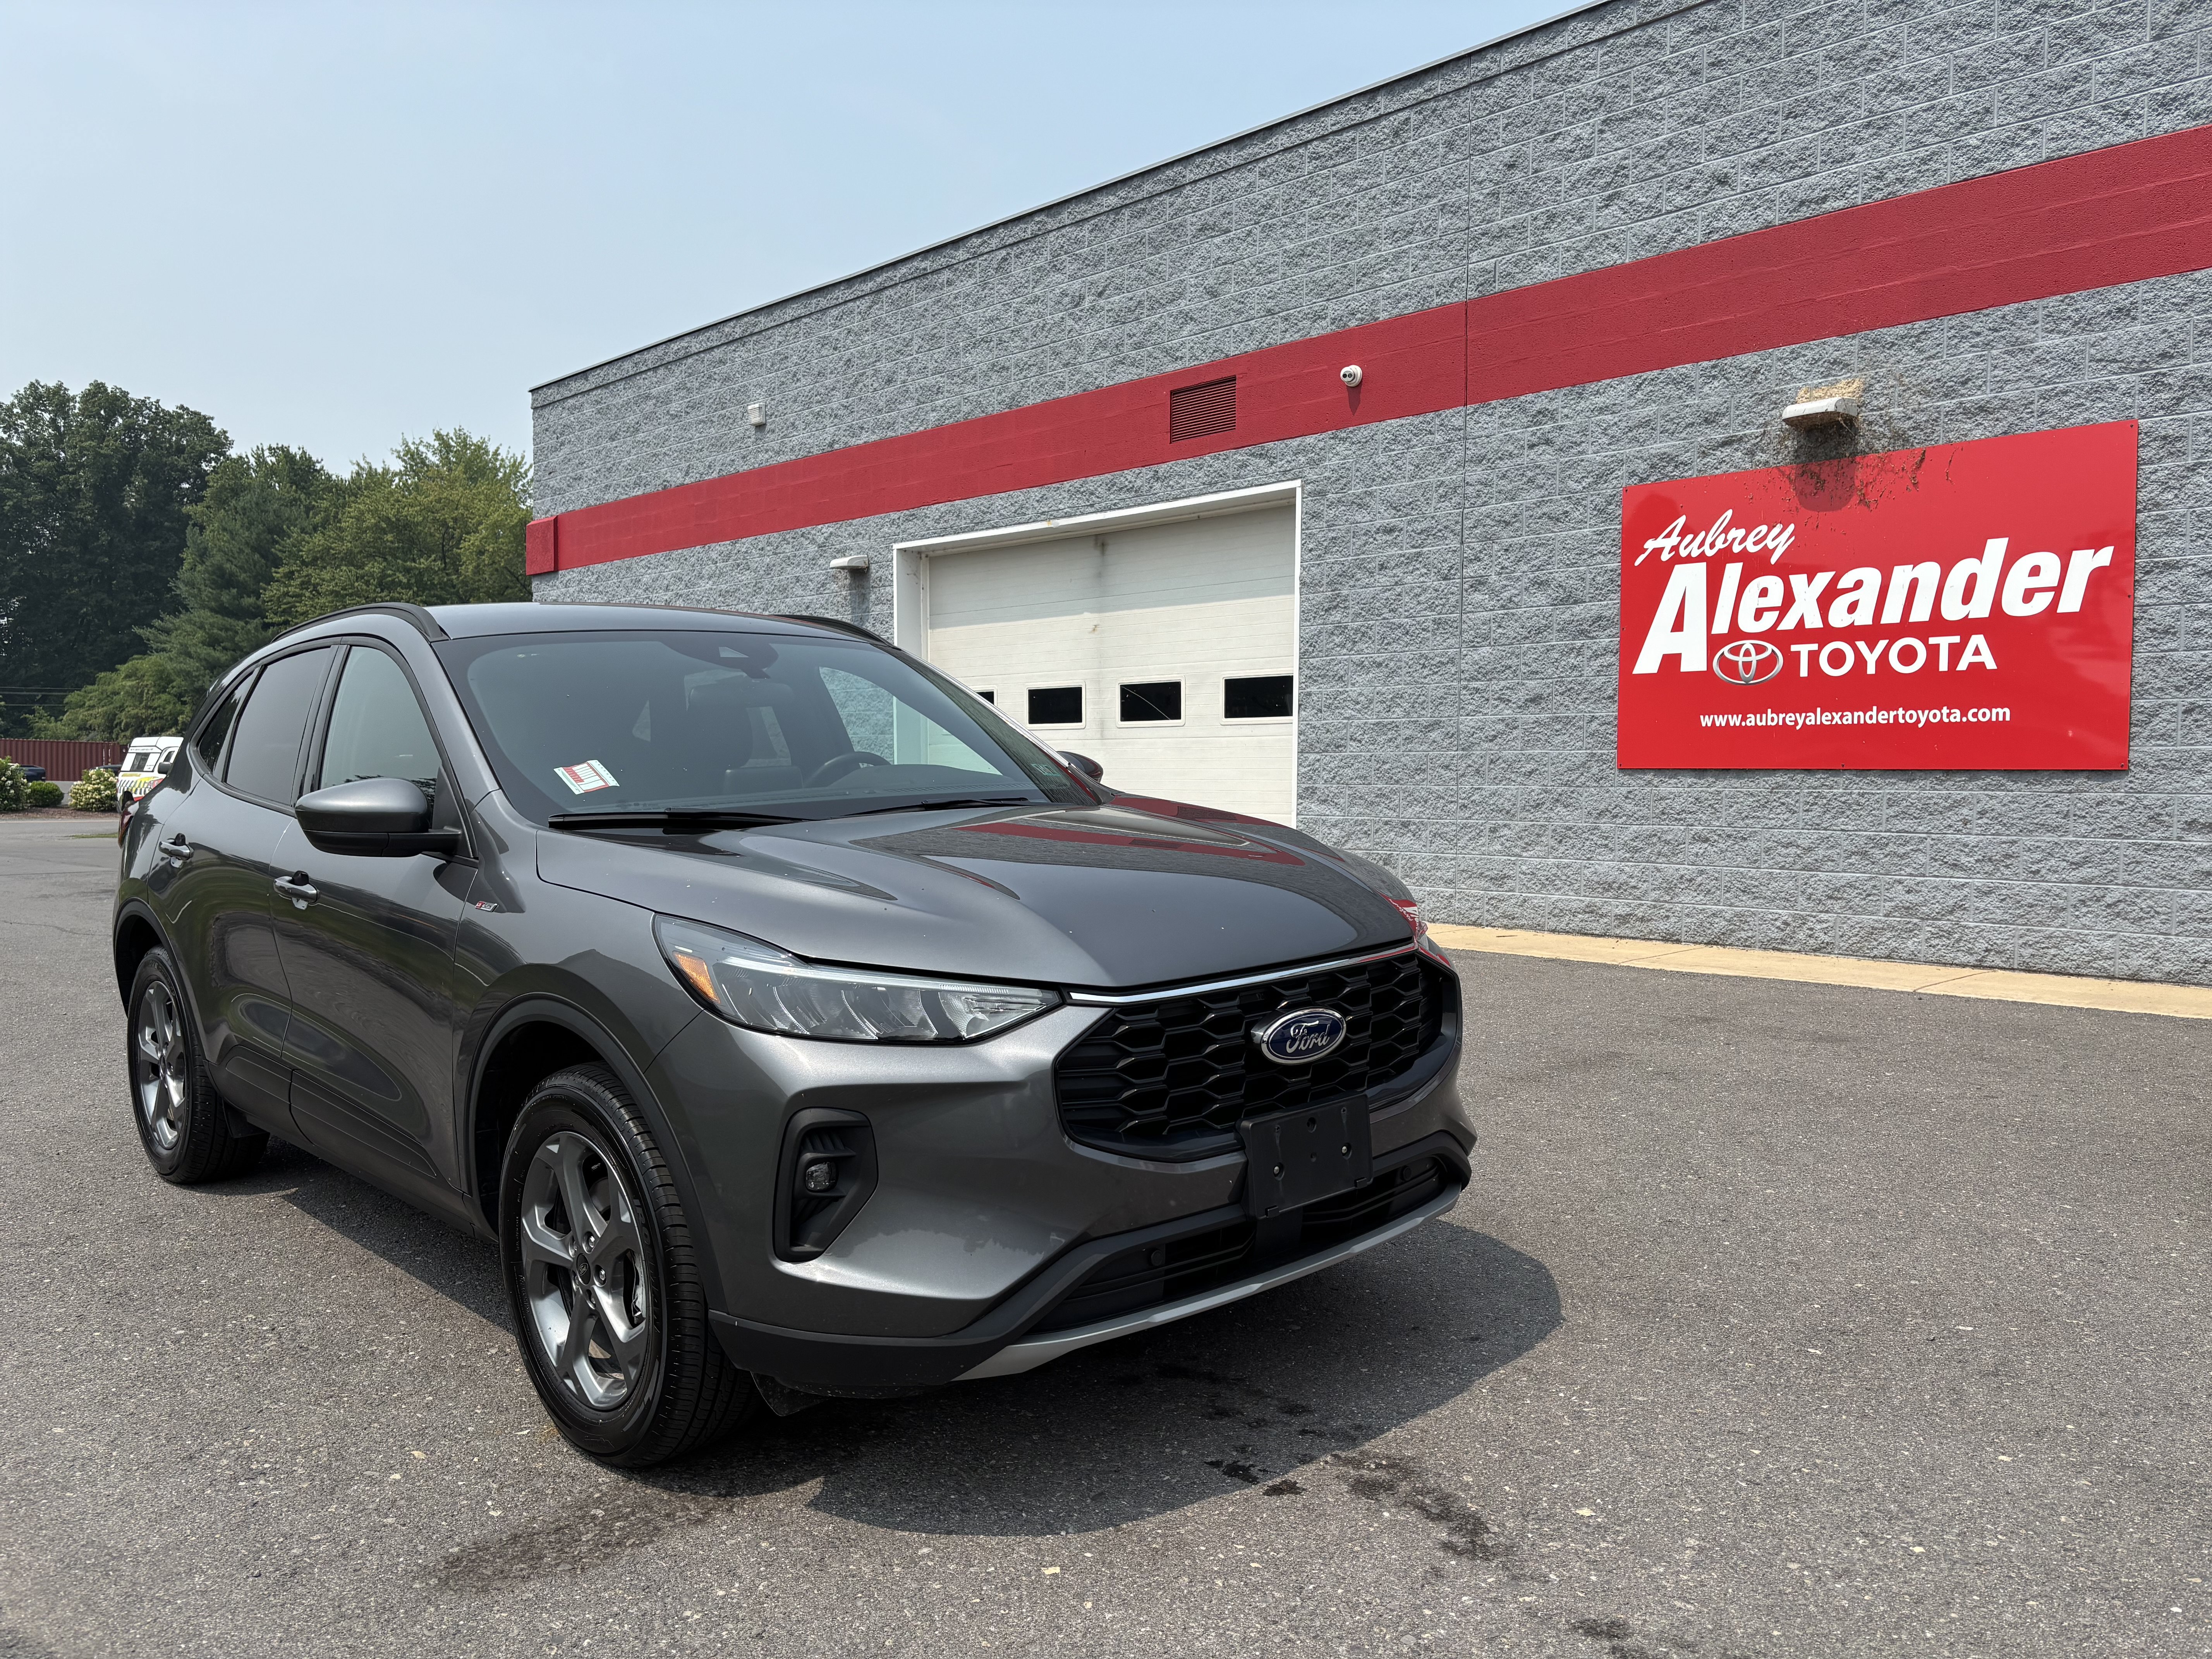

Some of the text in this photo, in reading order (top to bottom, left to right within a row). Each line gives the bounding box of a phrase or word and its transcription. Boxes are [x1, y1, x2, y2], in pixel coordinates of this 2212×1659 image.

[1635, 509, 1795, 565] Aubrey
[1632, 538, 2114, 674] Alexander
[1791, 634, 1997, 677] TOYOTA
[1700, 706, 2010, 730] www.aubreyalexandertoyota.com
[1286, 1020, 1330, 1053] Ford
